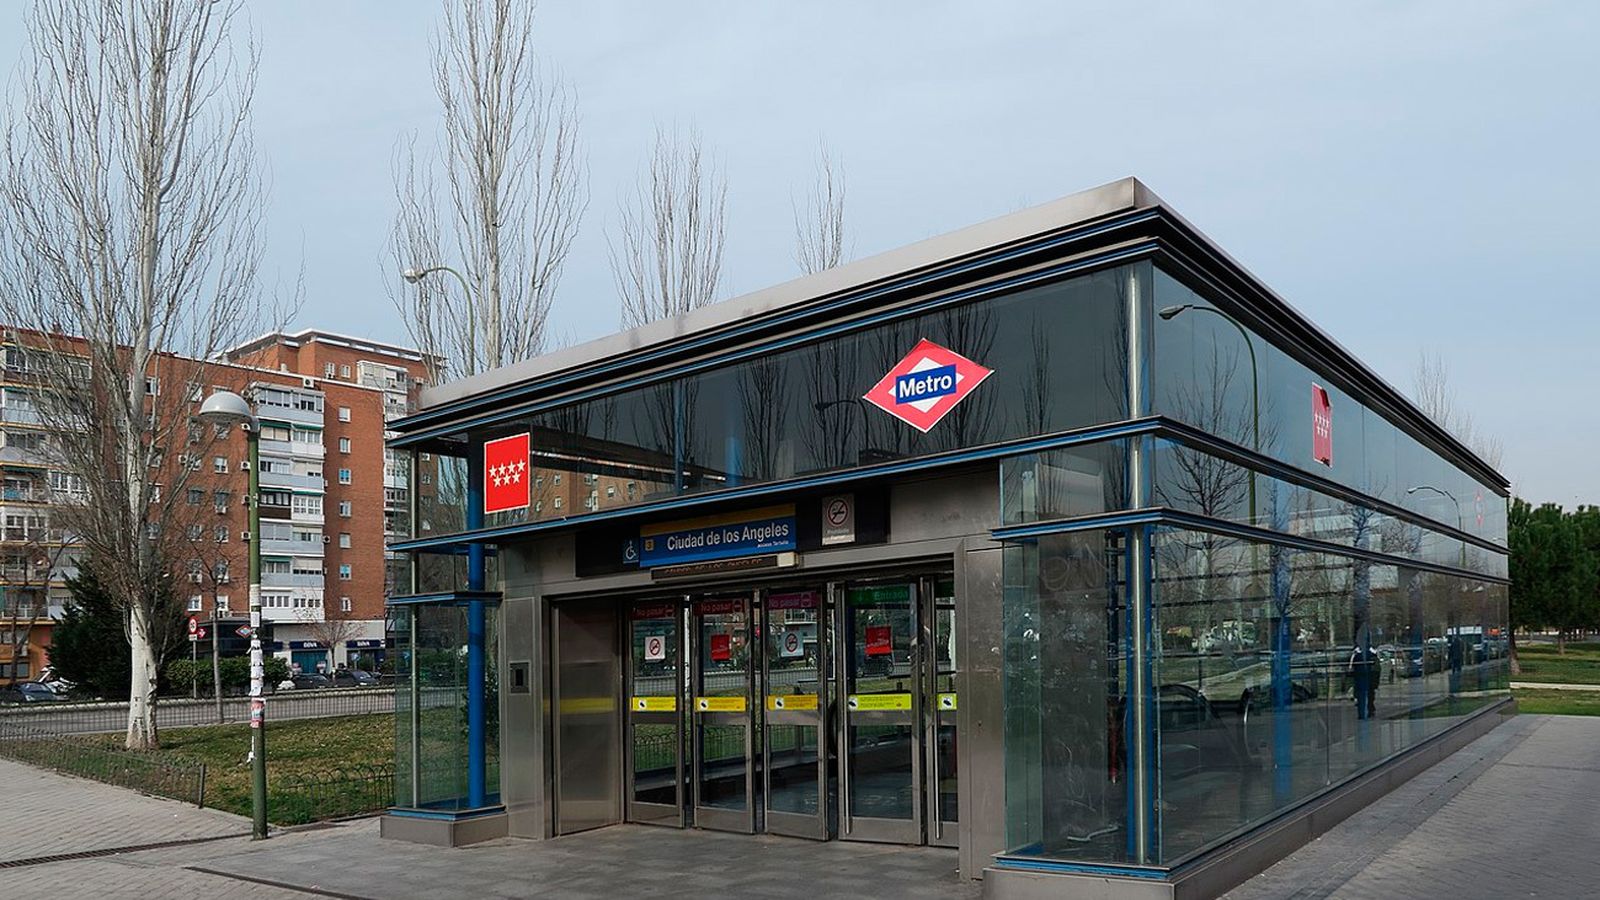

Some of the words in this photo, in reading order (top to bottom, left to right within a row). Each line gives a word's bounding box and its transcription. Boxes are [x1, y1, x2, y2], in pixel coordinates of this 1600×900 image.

[899, 375, 952, 398] Metro
[667, 533, 704, 551] Ciudad
[706, 531, 720, 546] de
[723, 529, 740, 544] los
[742, 522, 789, 543] Angeles
